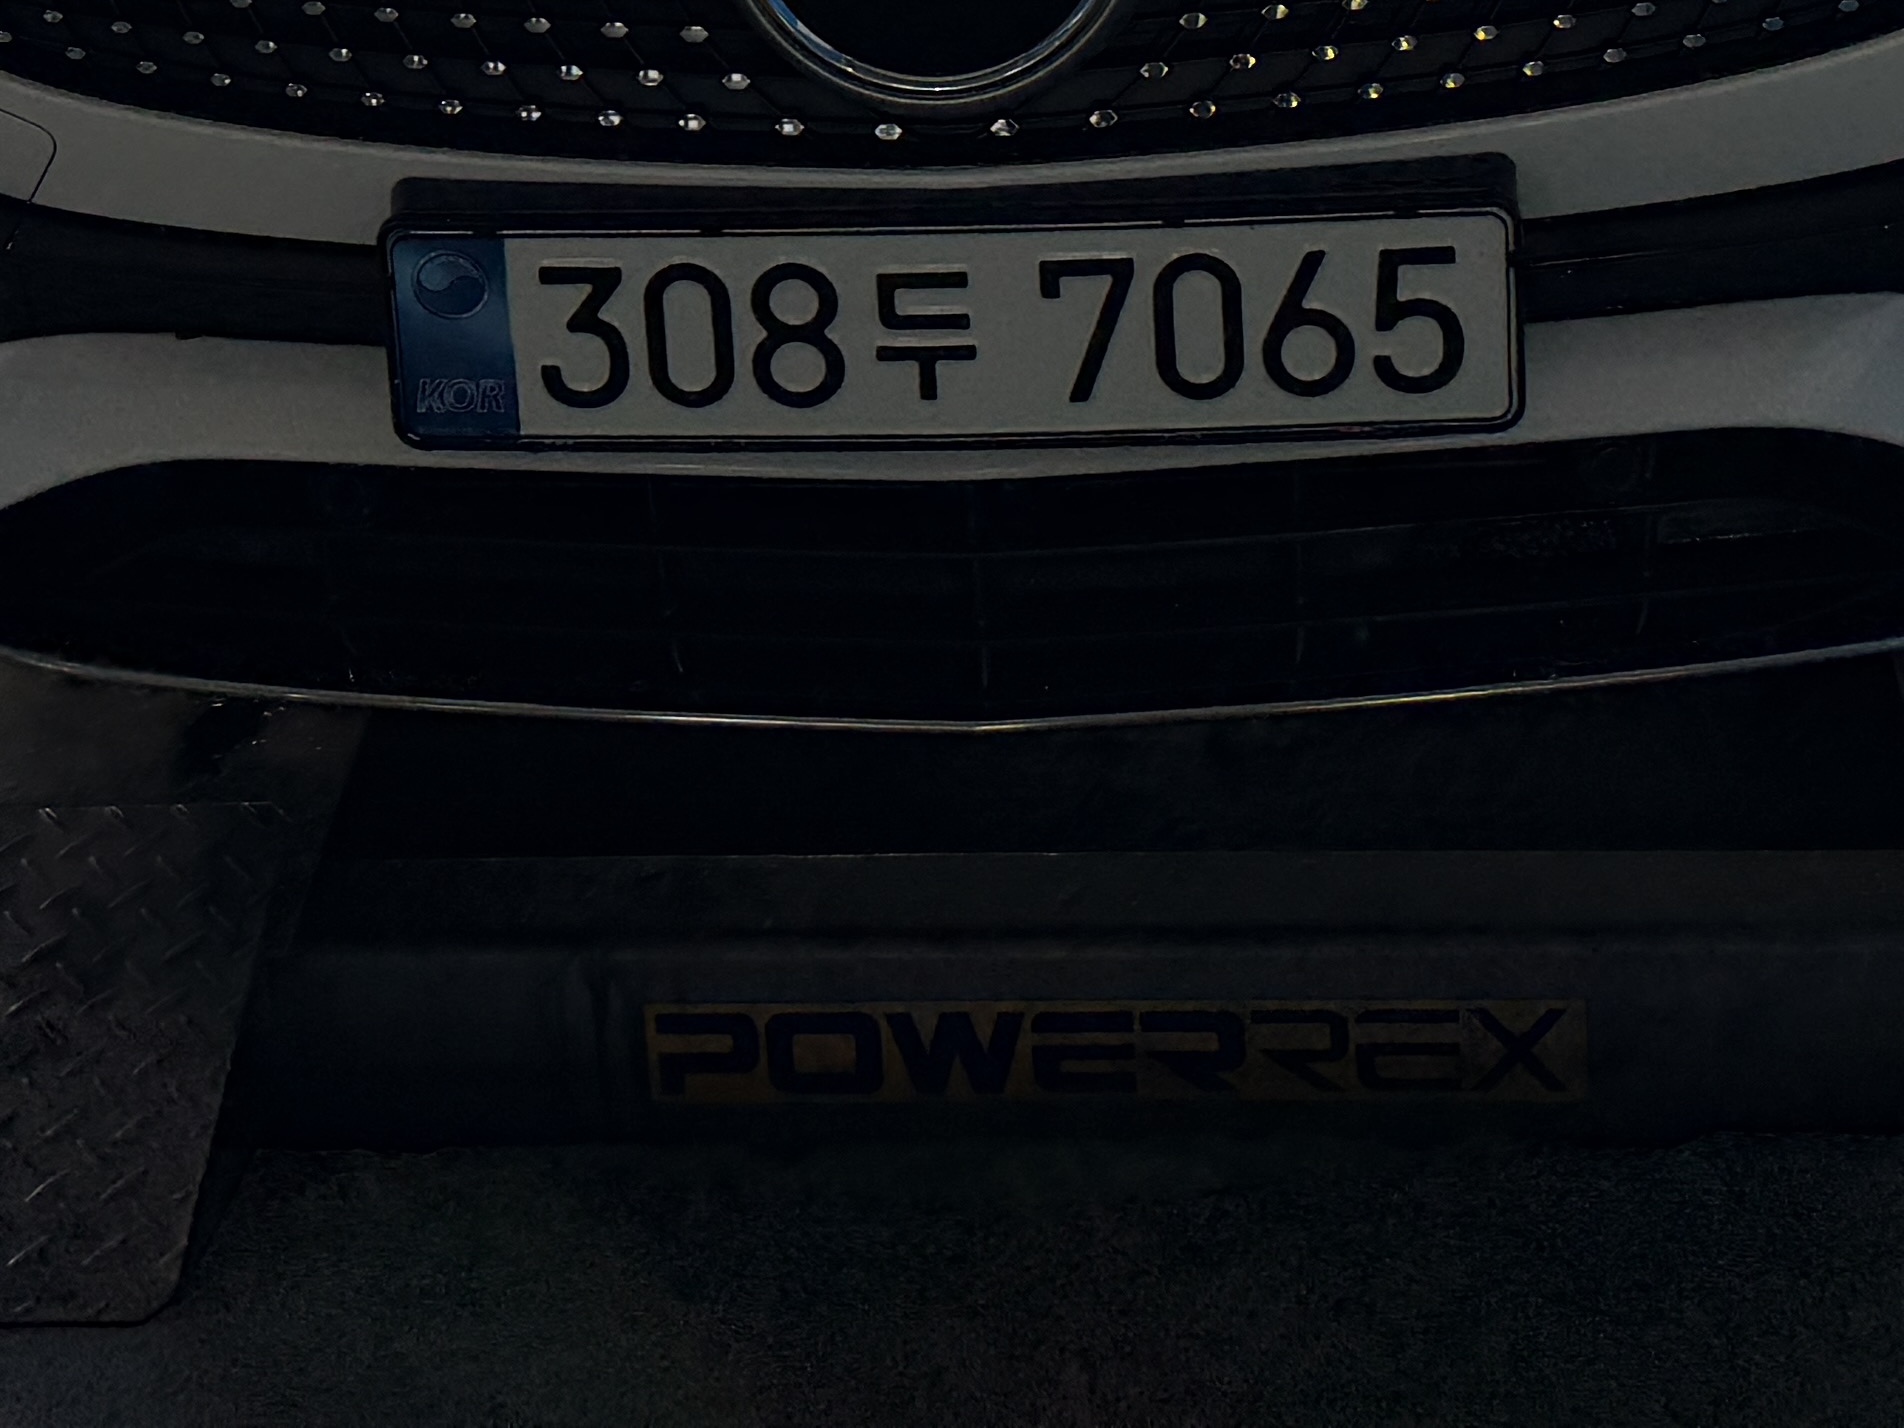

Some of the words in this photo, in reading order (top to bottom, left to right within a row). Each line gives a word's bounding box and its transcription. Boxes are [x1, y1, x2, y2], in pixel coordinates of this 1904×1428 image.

[537, 258, 977, 410] 308두
[1038, 246, 1464, 403] 7065
[417, 378, 505, 414] KOR
[653, 1007, 1568, 1094] POWERREX
